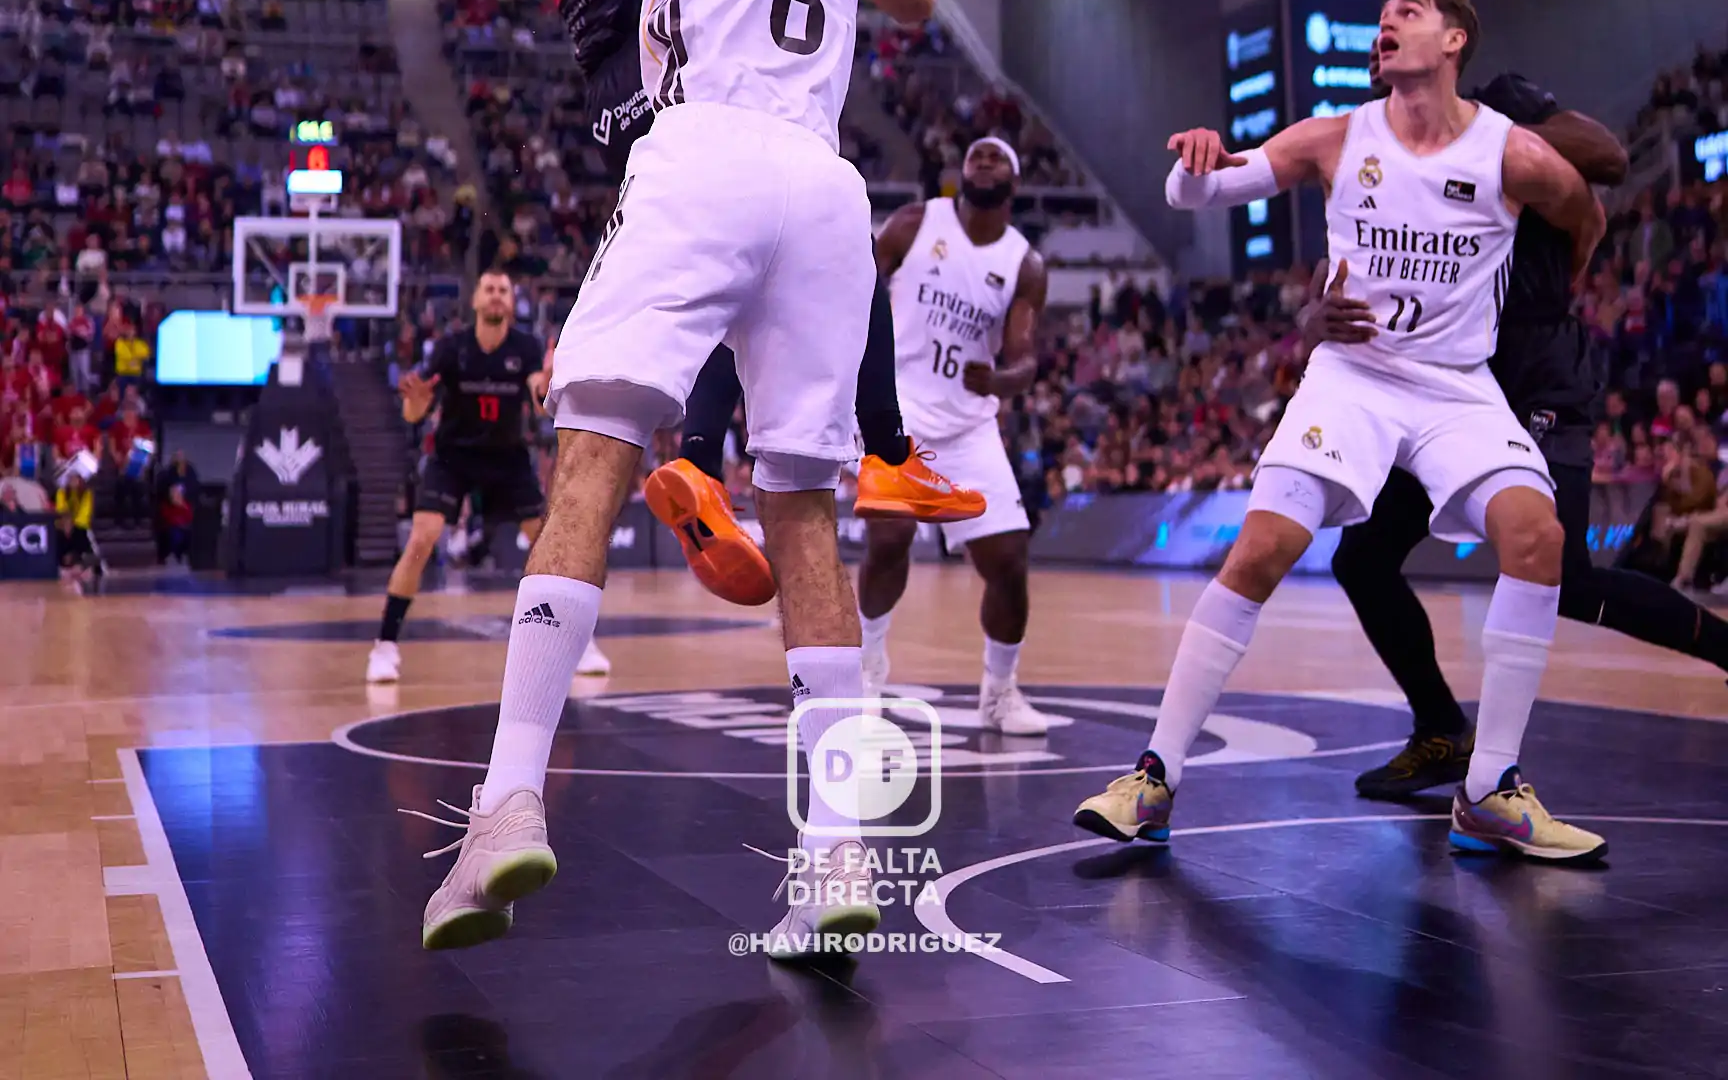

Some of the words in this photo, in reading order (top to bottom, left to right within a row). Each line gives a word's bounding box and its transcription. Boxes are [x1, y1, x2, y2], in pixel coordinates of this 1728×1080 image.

[1355, 219, 1481, 257] Emirates
[1368, 255, 1395, 278] FLY
[1400, 257, 1460, 284] BETTER
[932, 339, 962, 379] 16
[518, 613, 561, 628] adidas
